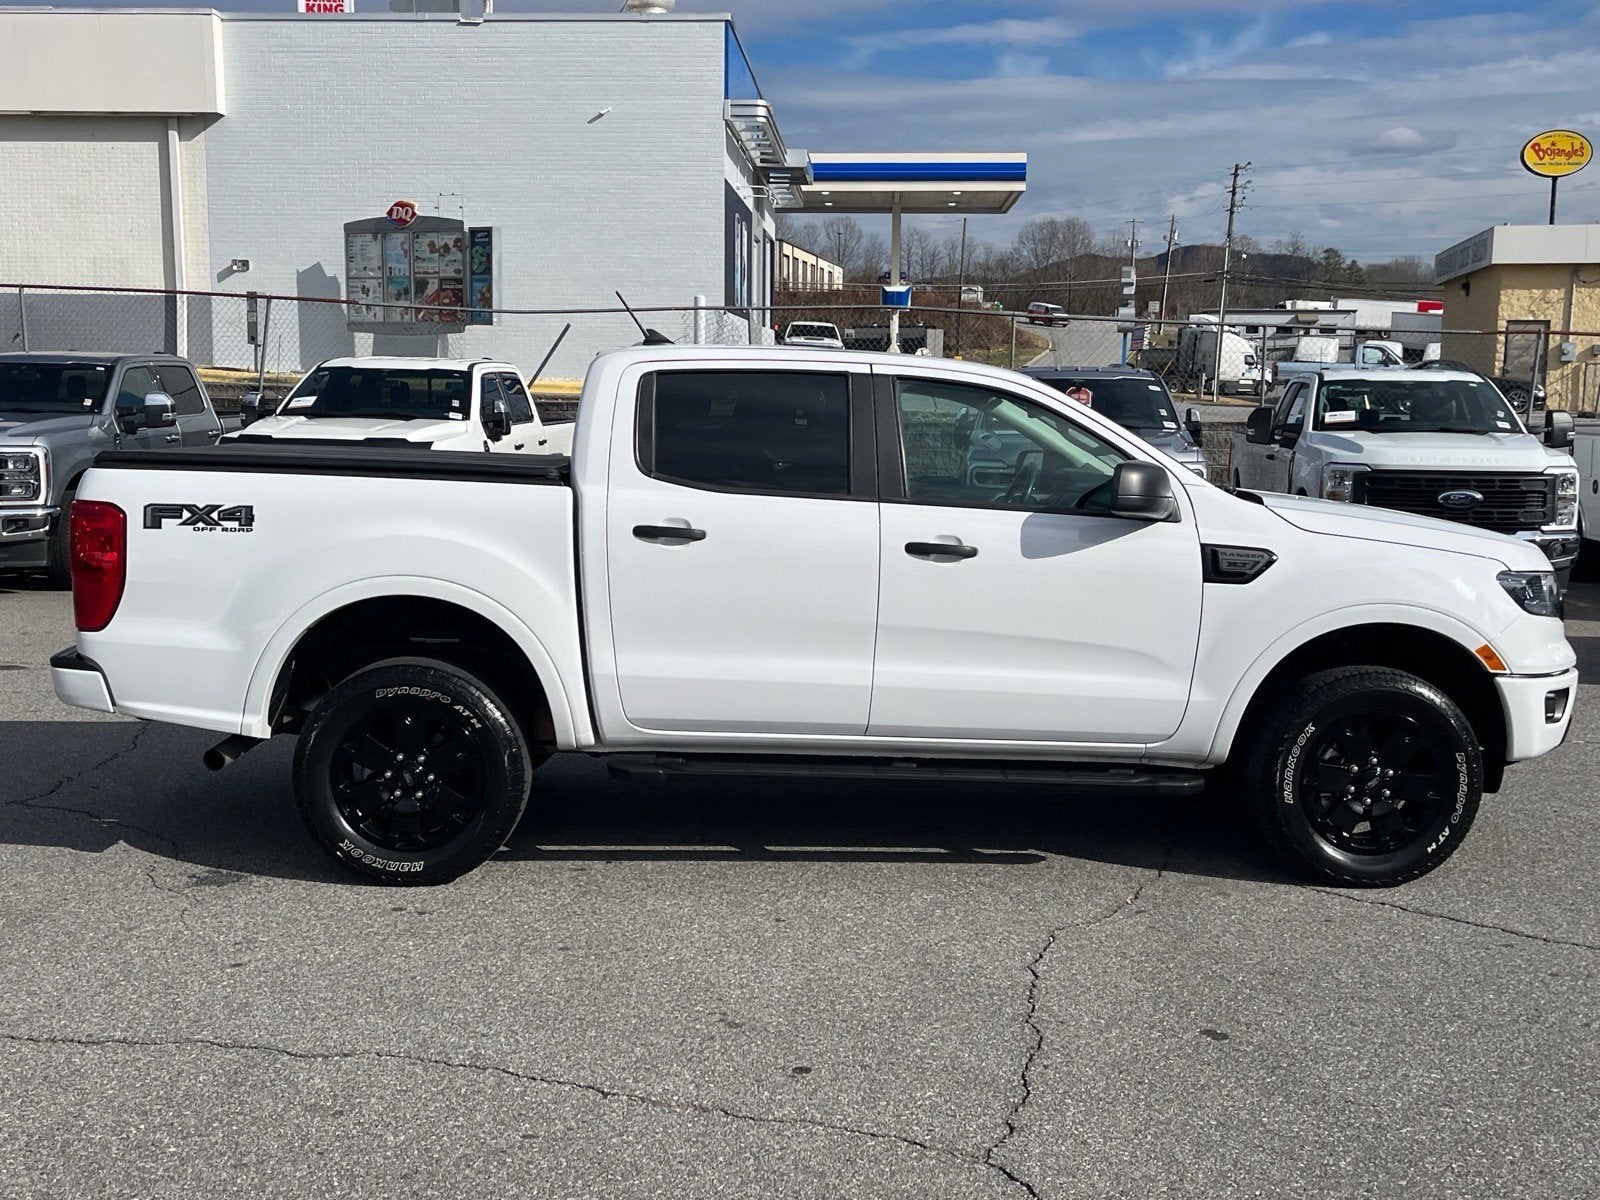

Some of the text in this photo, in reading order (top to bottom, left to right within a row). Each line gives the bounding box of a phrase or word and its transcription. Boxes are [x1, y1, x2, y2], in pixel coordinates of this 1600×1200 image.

[391, 206, 413, 222] DQ
[143, 503, 255, 530] FX4
[1220, 551, 1265, 559] RANGER
